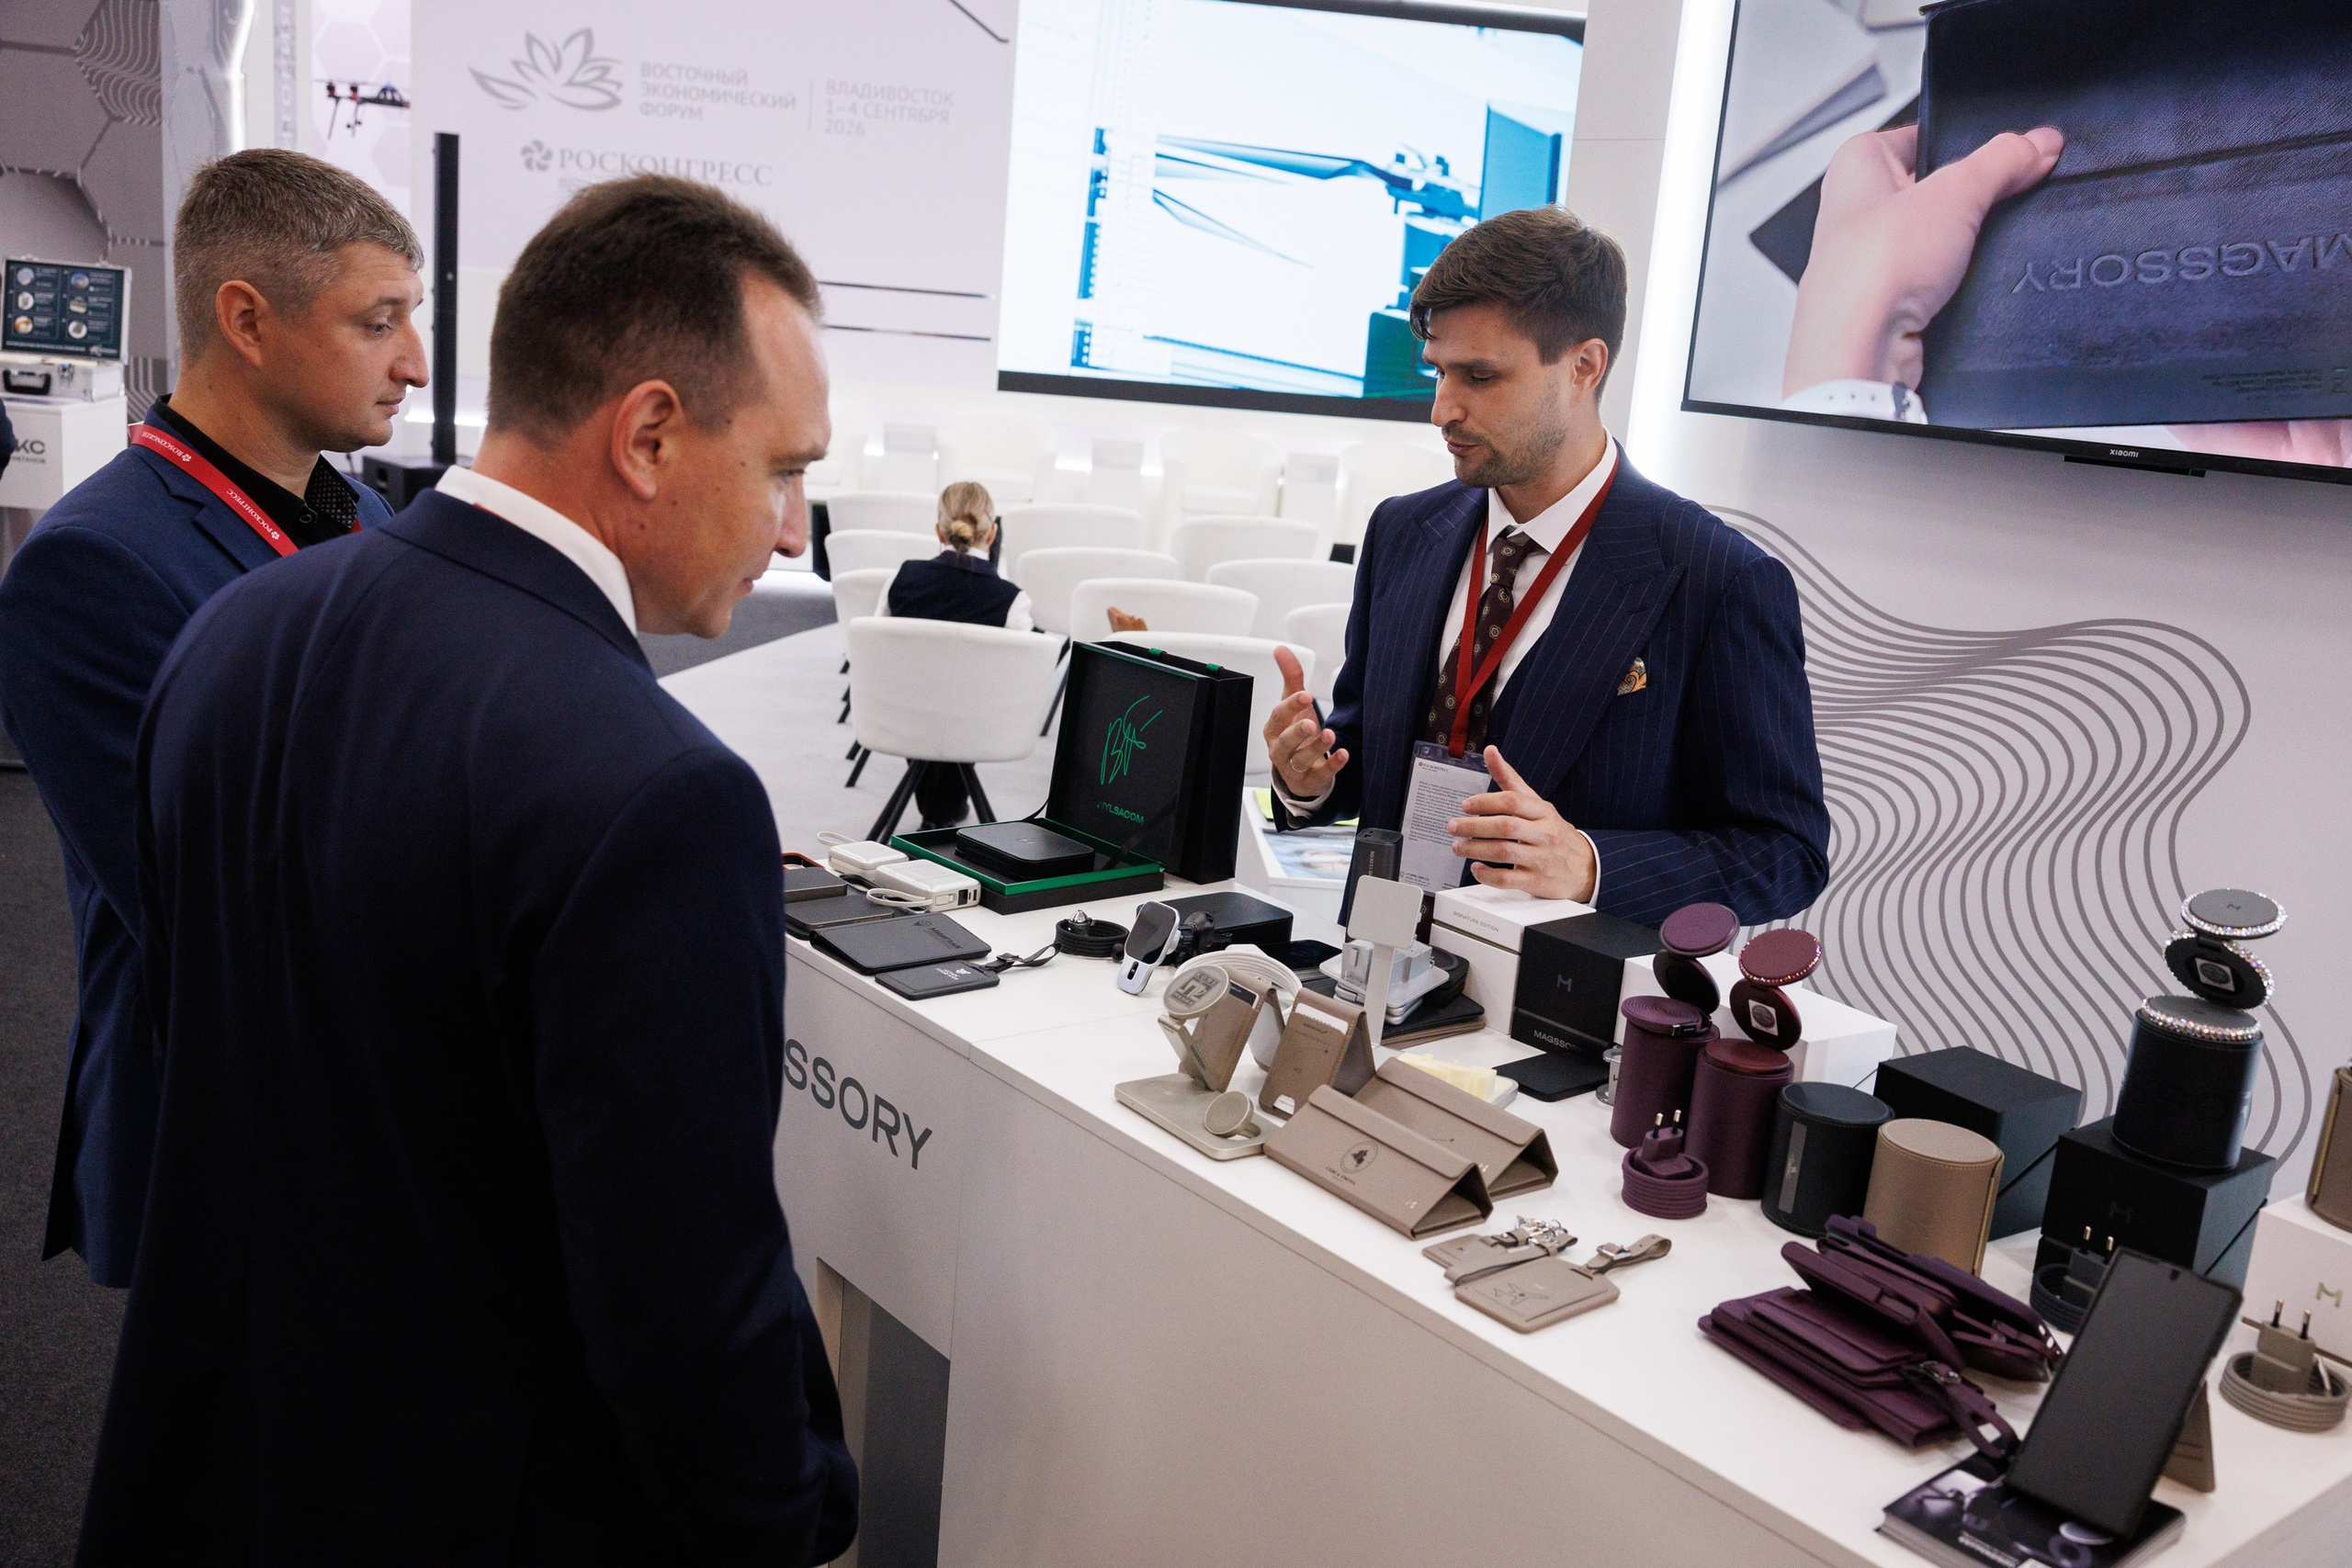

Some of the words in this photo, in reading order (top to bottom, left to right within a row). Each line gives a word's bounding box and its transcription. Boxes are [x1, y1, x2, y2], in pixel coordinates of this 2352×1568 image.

[640, 62, 749, 85] ВОСТОЧНЫЙ
[639, 81, 797, 110] ЭКОНОМИЧЕСКИЙ
[825, 79, 955, 107] ВЛАДИВОСТОК
[639, 101, 704, 120] ФОРУМ
[863, 102, 950, 125] СЕНТЯБРЯ
[824, 118, 865, 137] 2026
[559, 148, 774, 186] РОСКОНГРЕСС
[226, 489, 273, 533] РОСКОНГРЕСС
[1453, 910, 1479, 925] SIGNATURE
[1479, 921, 1499, 932] EDITION
